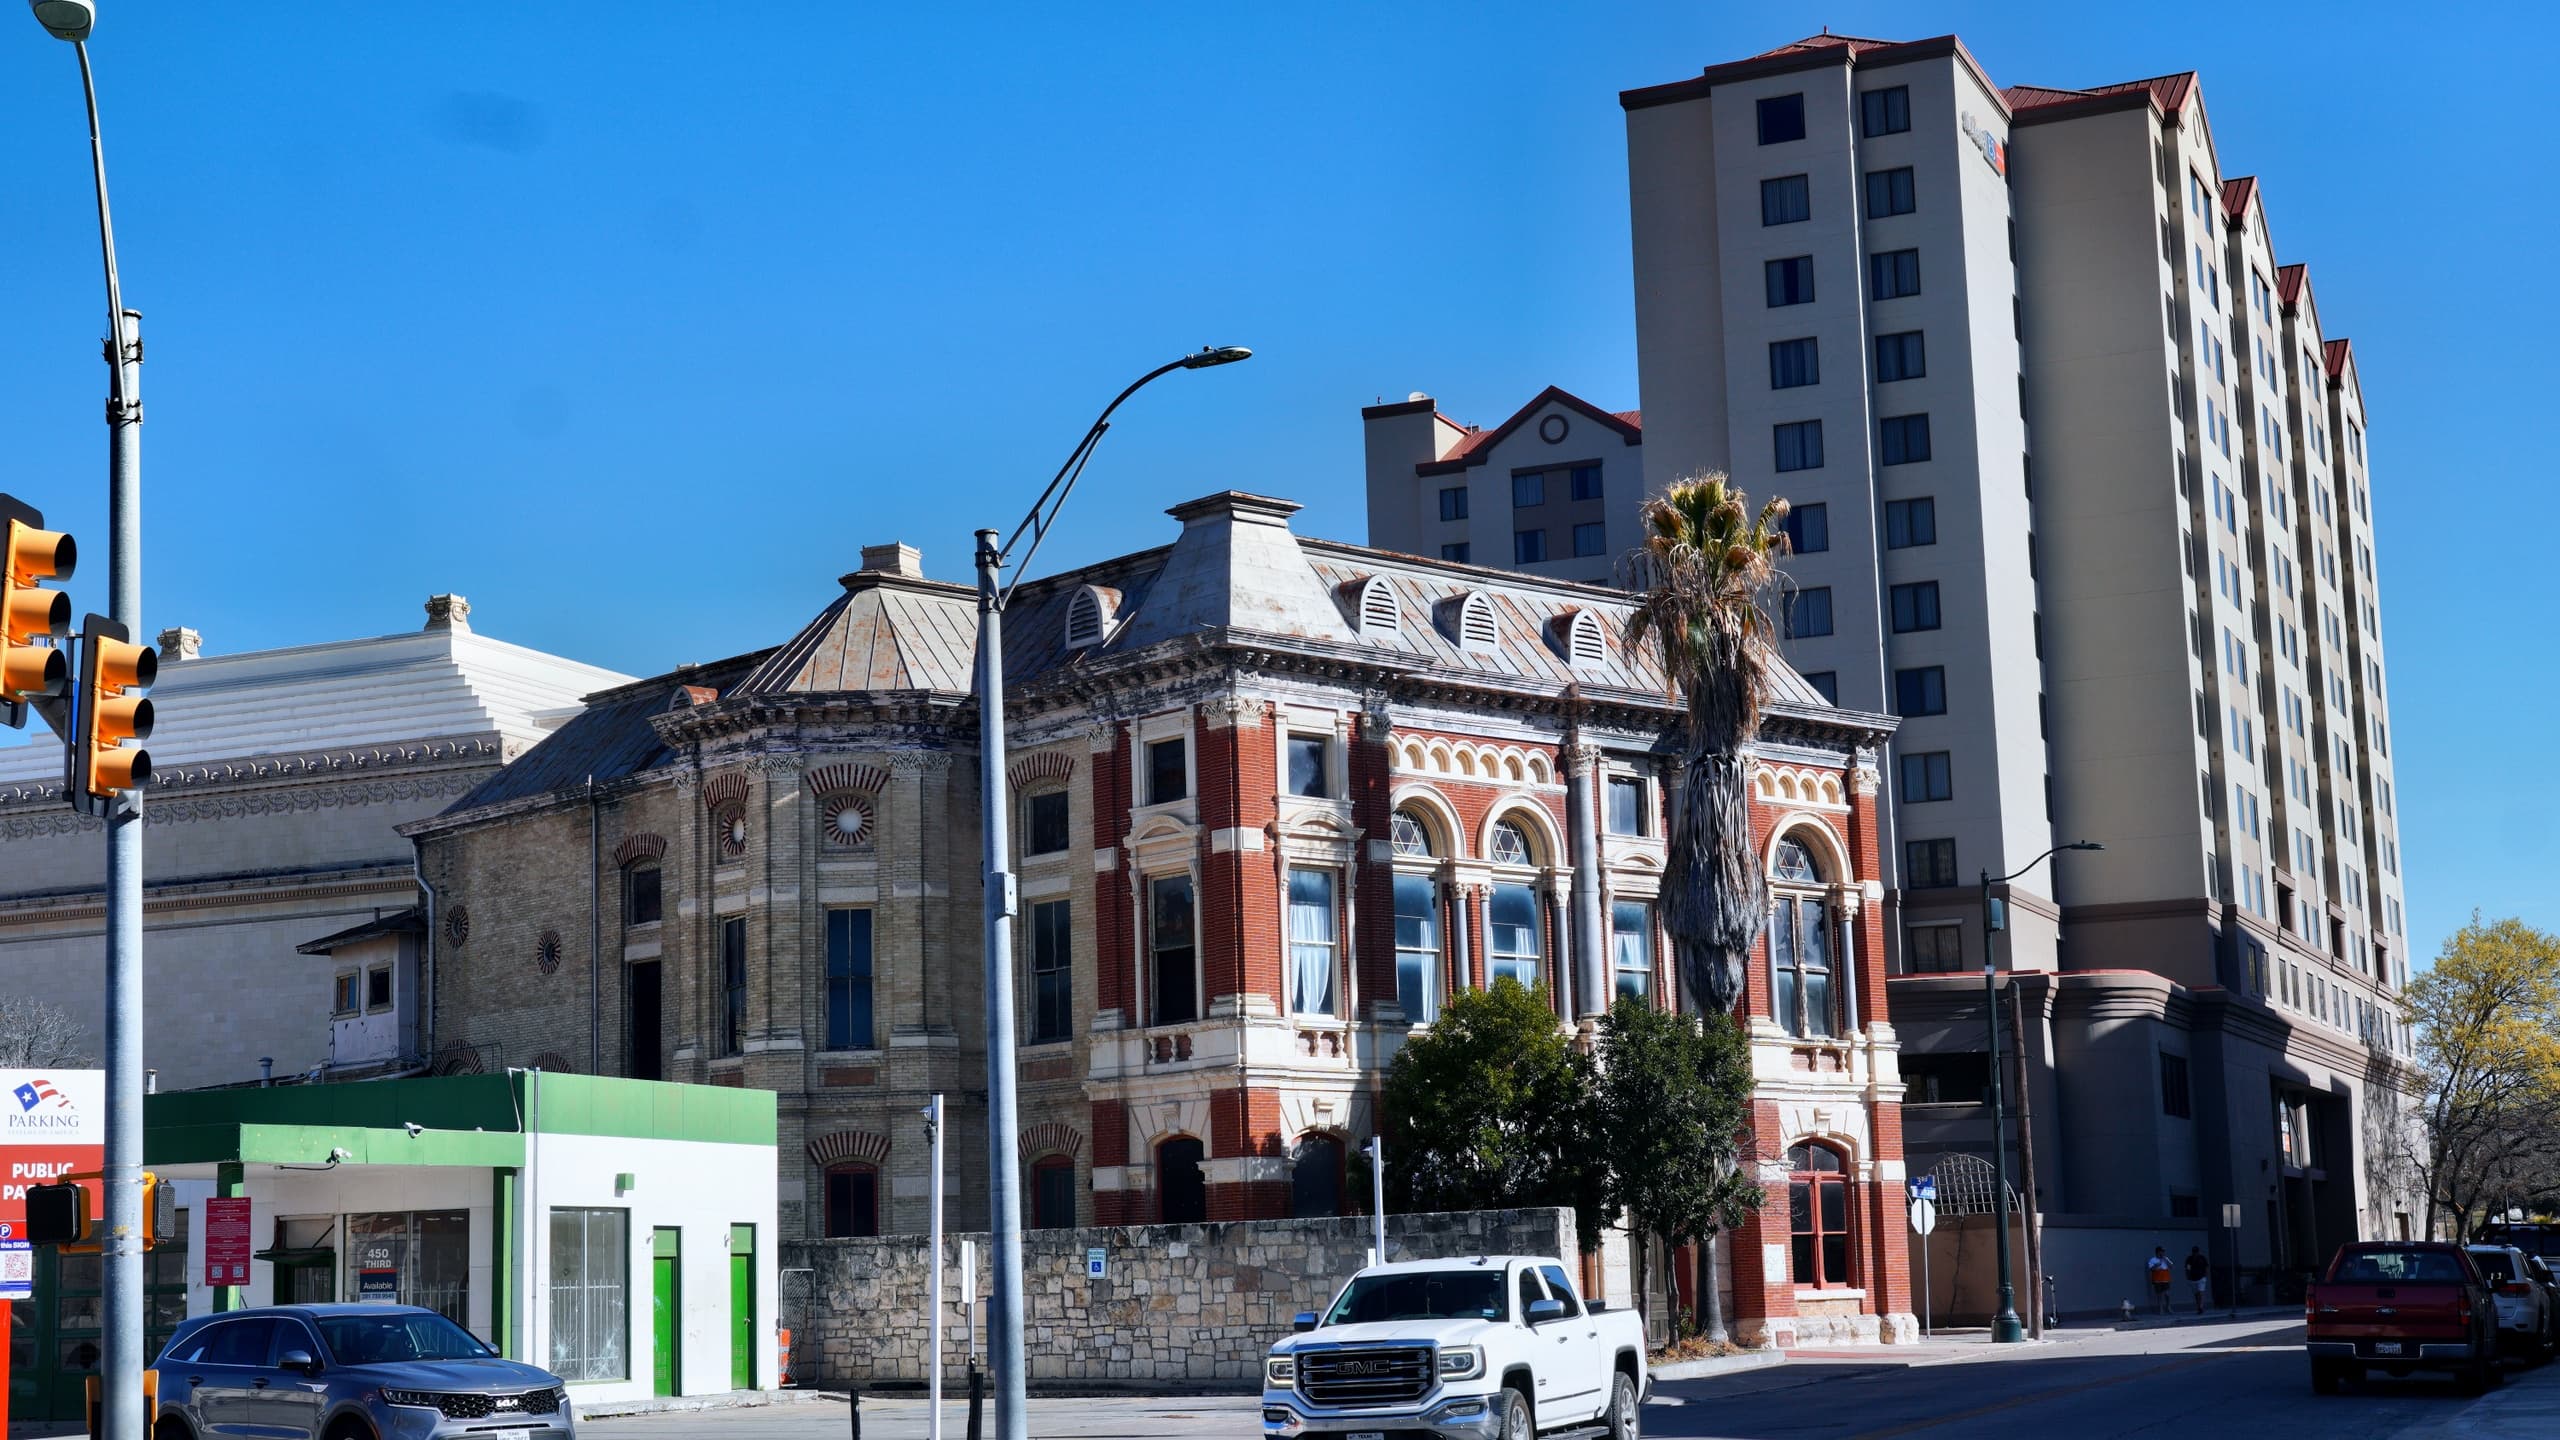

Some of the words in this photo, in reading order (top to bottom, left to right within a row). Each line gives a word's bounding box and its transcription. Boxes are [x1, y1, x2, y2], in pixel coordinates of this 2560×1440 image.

[8, 1114, 80, 1128] PARKING
[12, 1162, 74, 1178] PUBLIC
[1, 1226, 10, 1236] P
[13, 1241, 30, 1249] SIGN
[367, 1248, 389, 1259] 450
[364, 1260, 392, 1269] THIRD
[363, 1281, 393, 1290] Available
[1336, 1360, 1390, 1374] GMC
